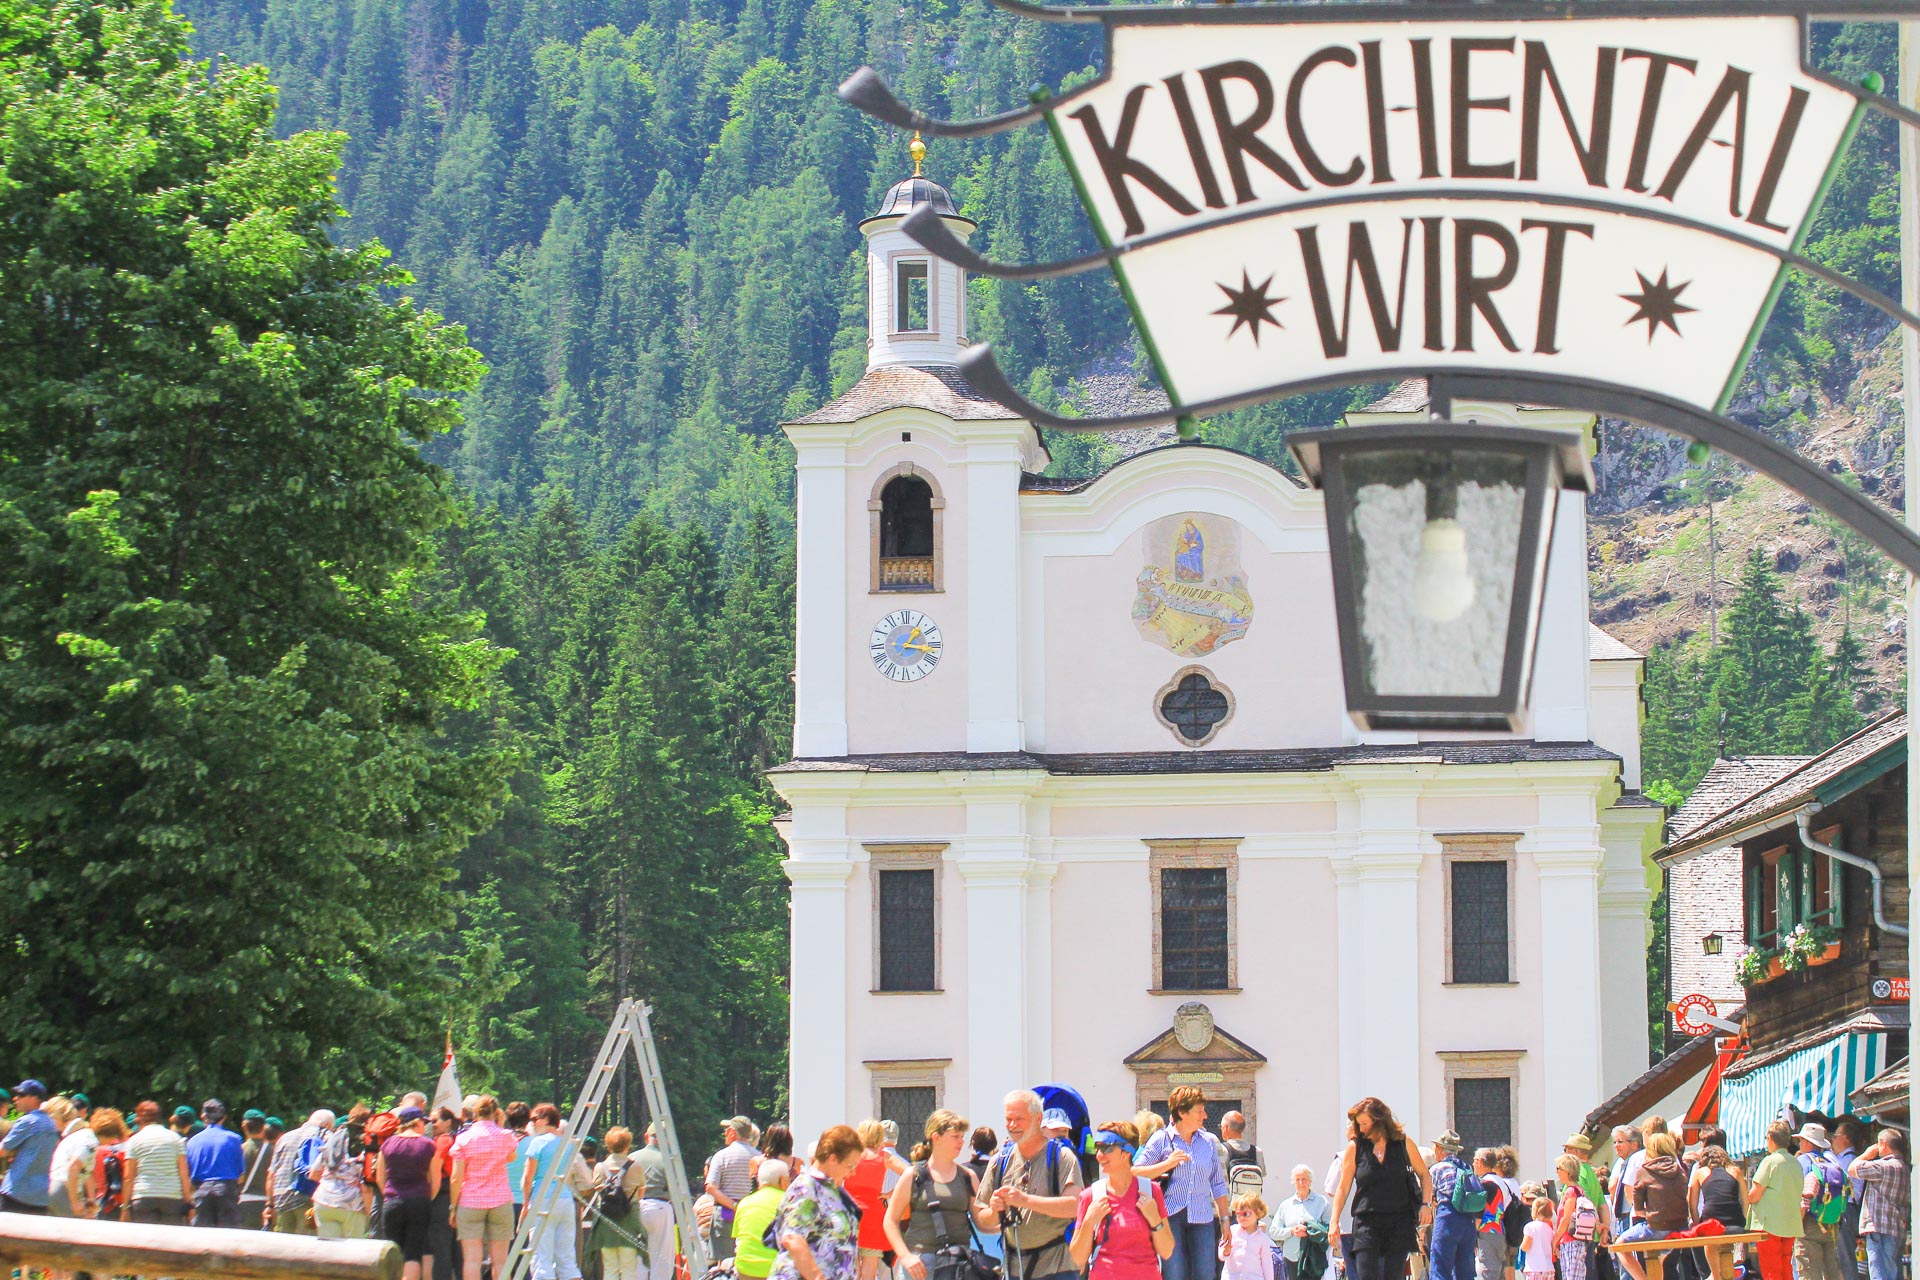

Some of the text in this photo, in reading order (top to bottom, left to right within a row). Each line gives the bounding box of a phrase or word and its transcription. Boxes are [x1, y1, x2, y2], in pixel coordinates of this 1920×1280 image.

[1068, 35, 1810, 238] KIRCHENTAL
[1296, 217, 1595, 359] WIRT
[924, 626, 937, 636] II
[1892, 989, 1911, 998] TRA
[1677, 995, 1715, 1015] AUSTRIA
[1678, 1018, 1710, 1035] TABAK
